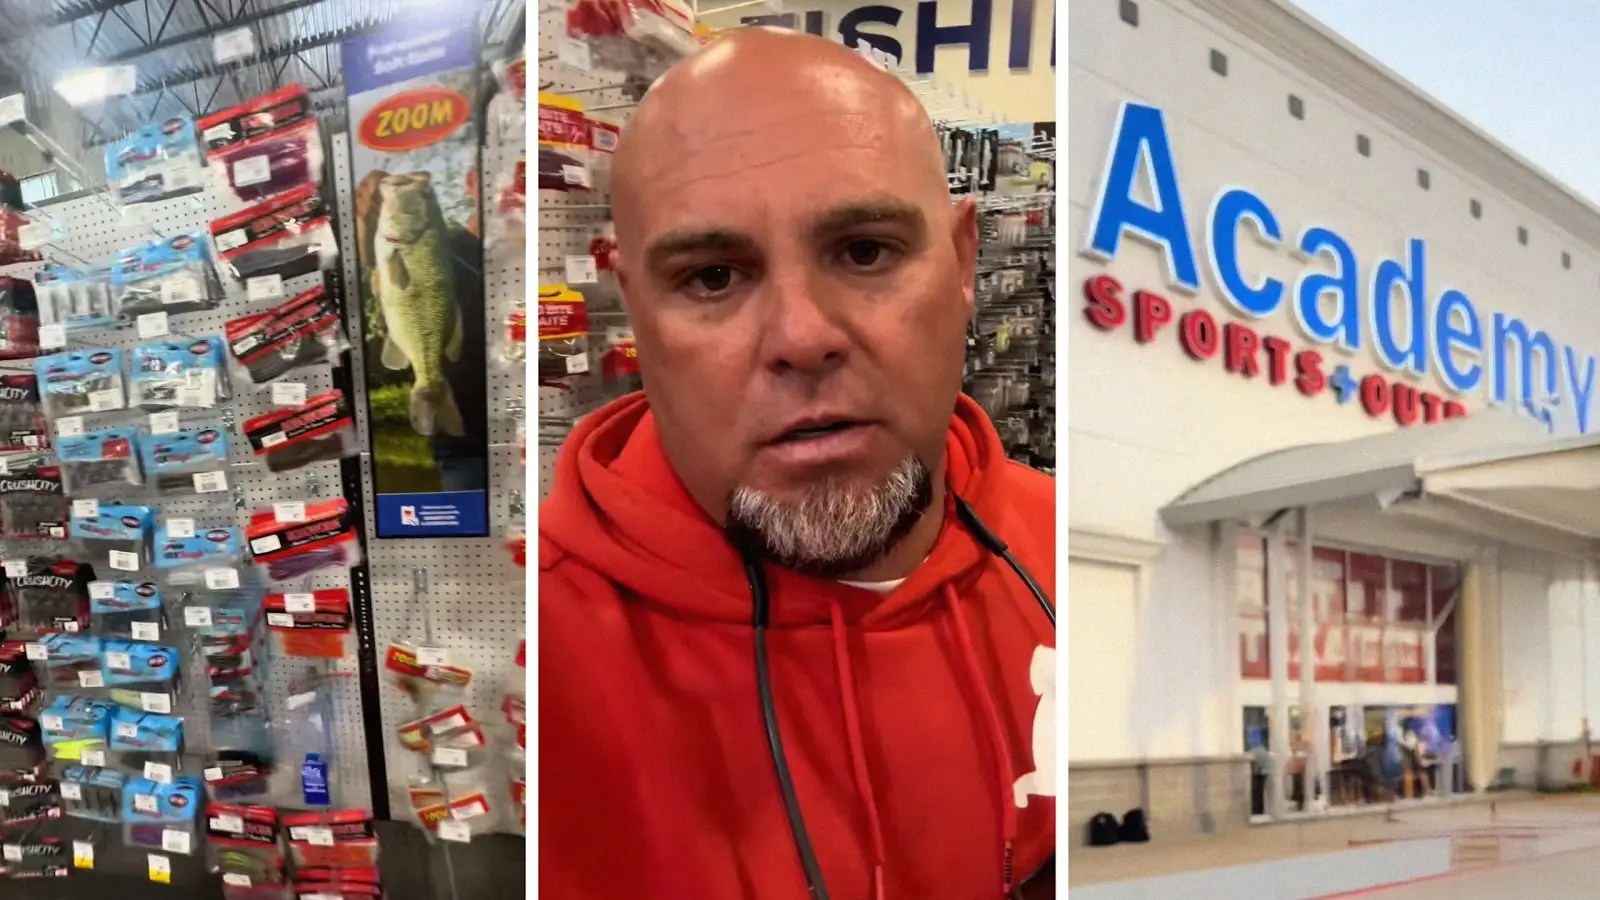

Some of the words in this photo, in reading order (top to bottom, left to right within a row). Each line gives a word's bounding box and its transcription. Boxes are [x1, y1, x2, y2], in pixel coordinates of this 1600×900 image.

[375, 99, 454, 138] ZOOM
[1080, 100, 1597, 434] Academy
[0, 479, 60, 493] CRUSHCITY
